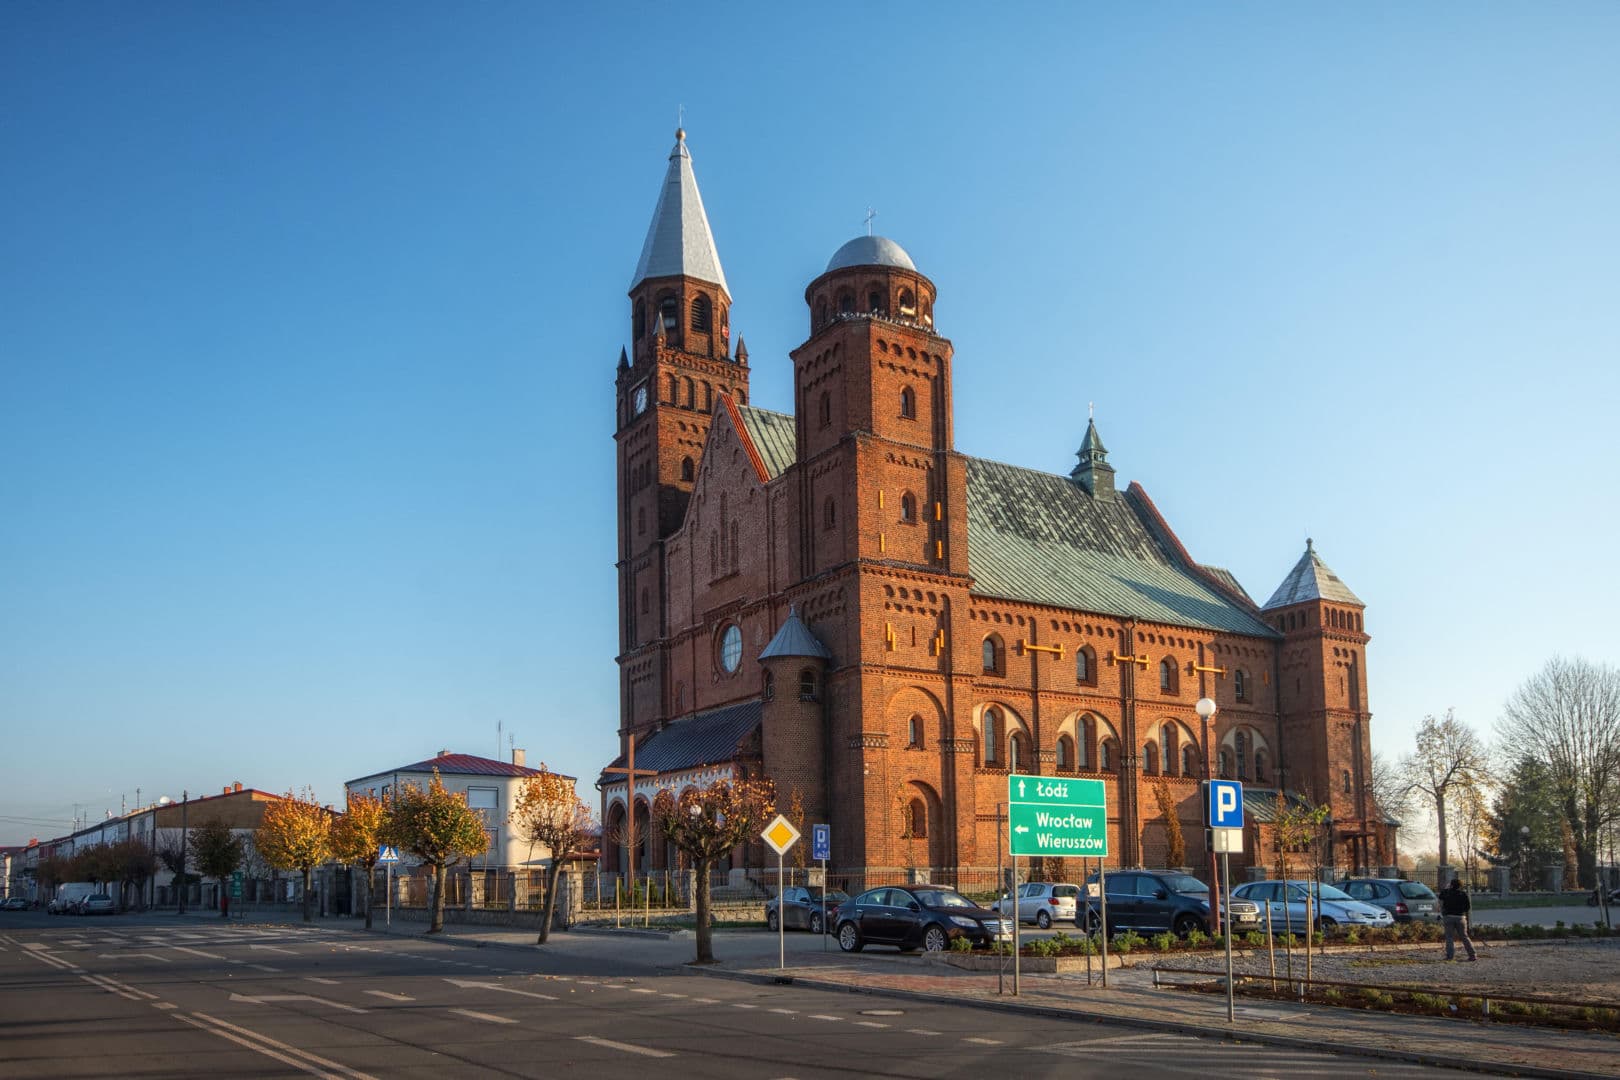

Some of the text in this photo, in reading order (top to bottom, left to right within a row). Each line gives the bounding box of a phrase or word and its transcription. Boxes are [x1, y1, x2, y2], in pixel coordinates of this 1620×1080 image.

[1036, 781, 1068, 798] Łódź
[1217, 785, 1236, 822] P
[1036, 812, 1093, 828] Wrocław
[1036, 833, 1103, 849] Wieruszów
